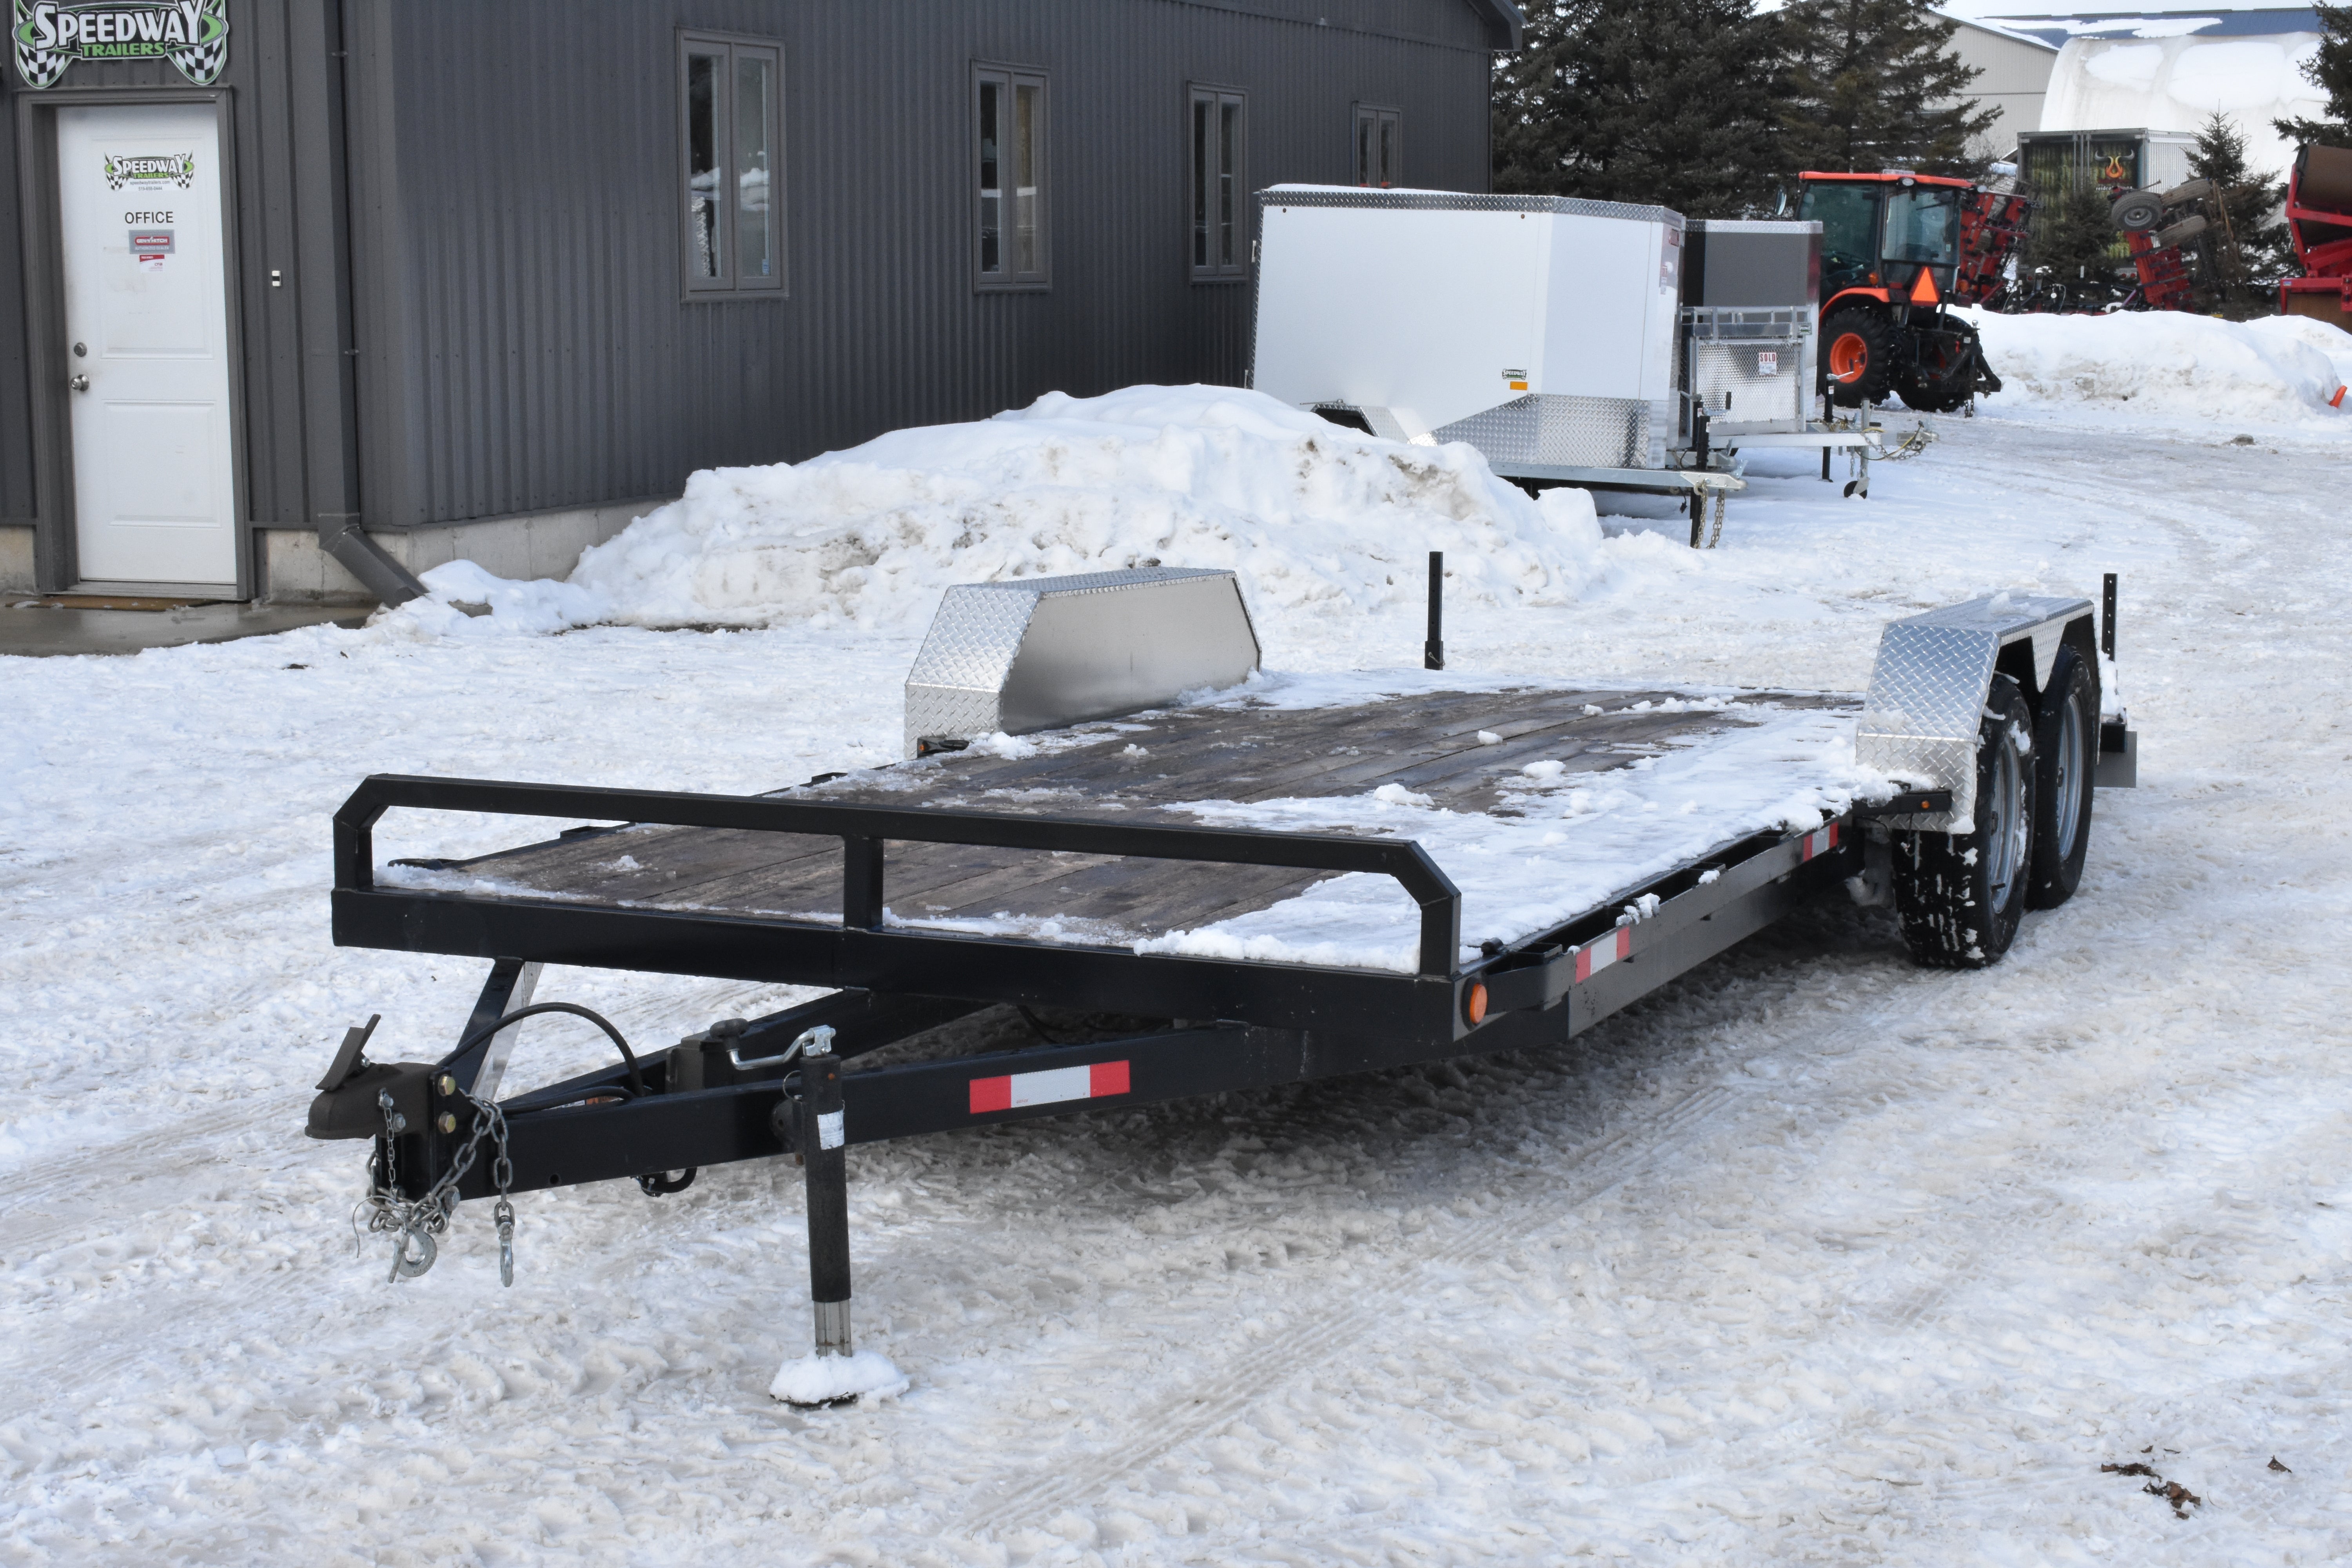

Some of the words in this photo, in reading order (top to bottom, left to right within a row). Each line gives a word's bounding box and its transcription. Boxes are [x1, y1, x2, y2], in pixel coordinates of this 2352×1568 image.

[34, 0, 203, 49] SPEEDWAY
[81, 42, 165, 57] TRAILERS
[113, 154, 185, 175] SPEEDWAY
[125, 211, 174, 224] OFFICE
[1760, 353, 1775, 362] SOLD
